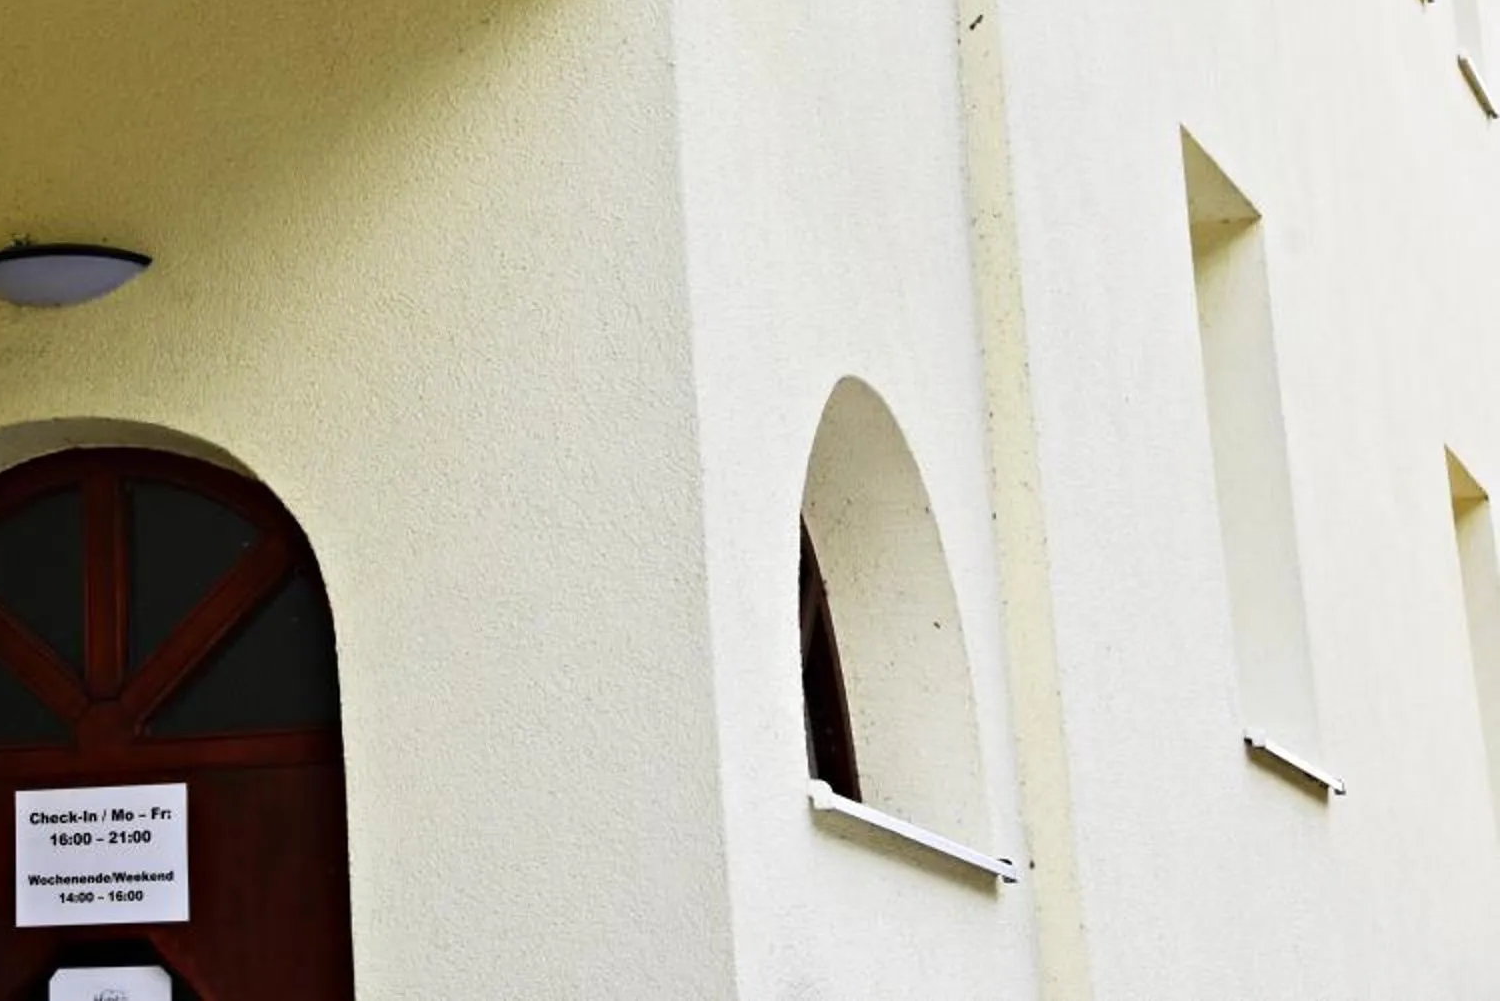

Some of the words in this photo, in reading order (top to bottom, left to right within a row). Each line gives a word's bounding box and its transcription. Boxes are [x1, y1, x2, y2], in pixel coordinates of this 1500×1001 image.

[29, 810, 98, 826] Check-In
[111, 808, 135, 822] Mo
[150, 806, 173, 821] Fr:
[49, 832, 93, 847] 16:00
[108, 829, 152, 844] 21:00
[59, 891, 95, 904] 14:00
[108, 889, 144, 902] 16:00
